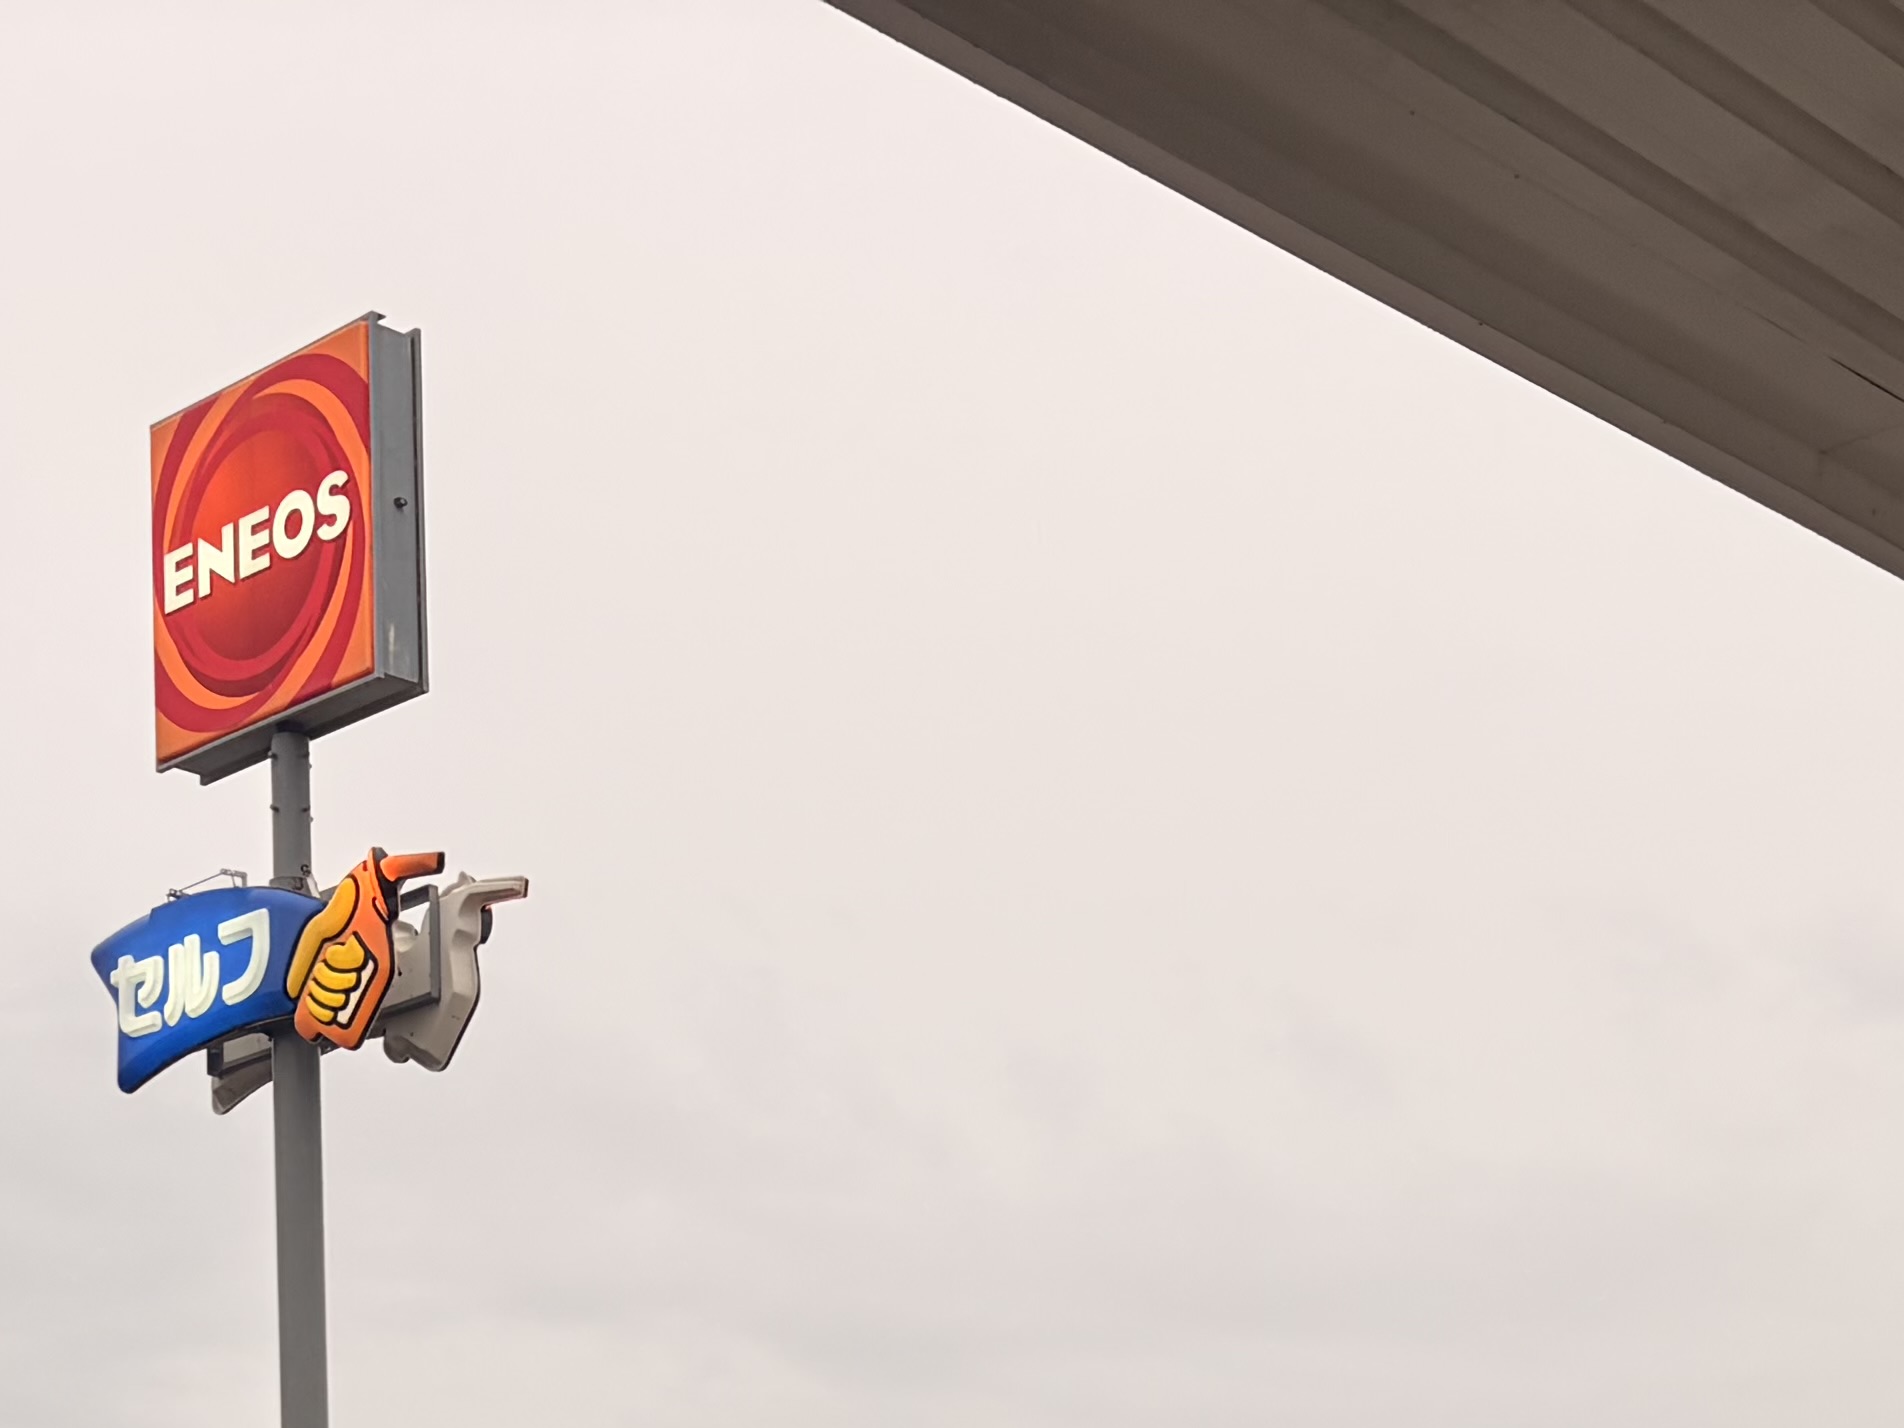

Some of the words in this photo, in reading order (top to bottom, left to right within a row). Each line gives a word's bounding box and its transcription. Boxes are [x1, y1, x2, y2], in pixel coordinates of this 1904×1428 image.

[164, 470, 351, 615] ENEOS
[110, 908, 270, 1038] セルフ
